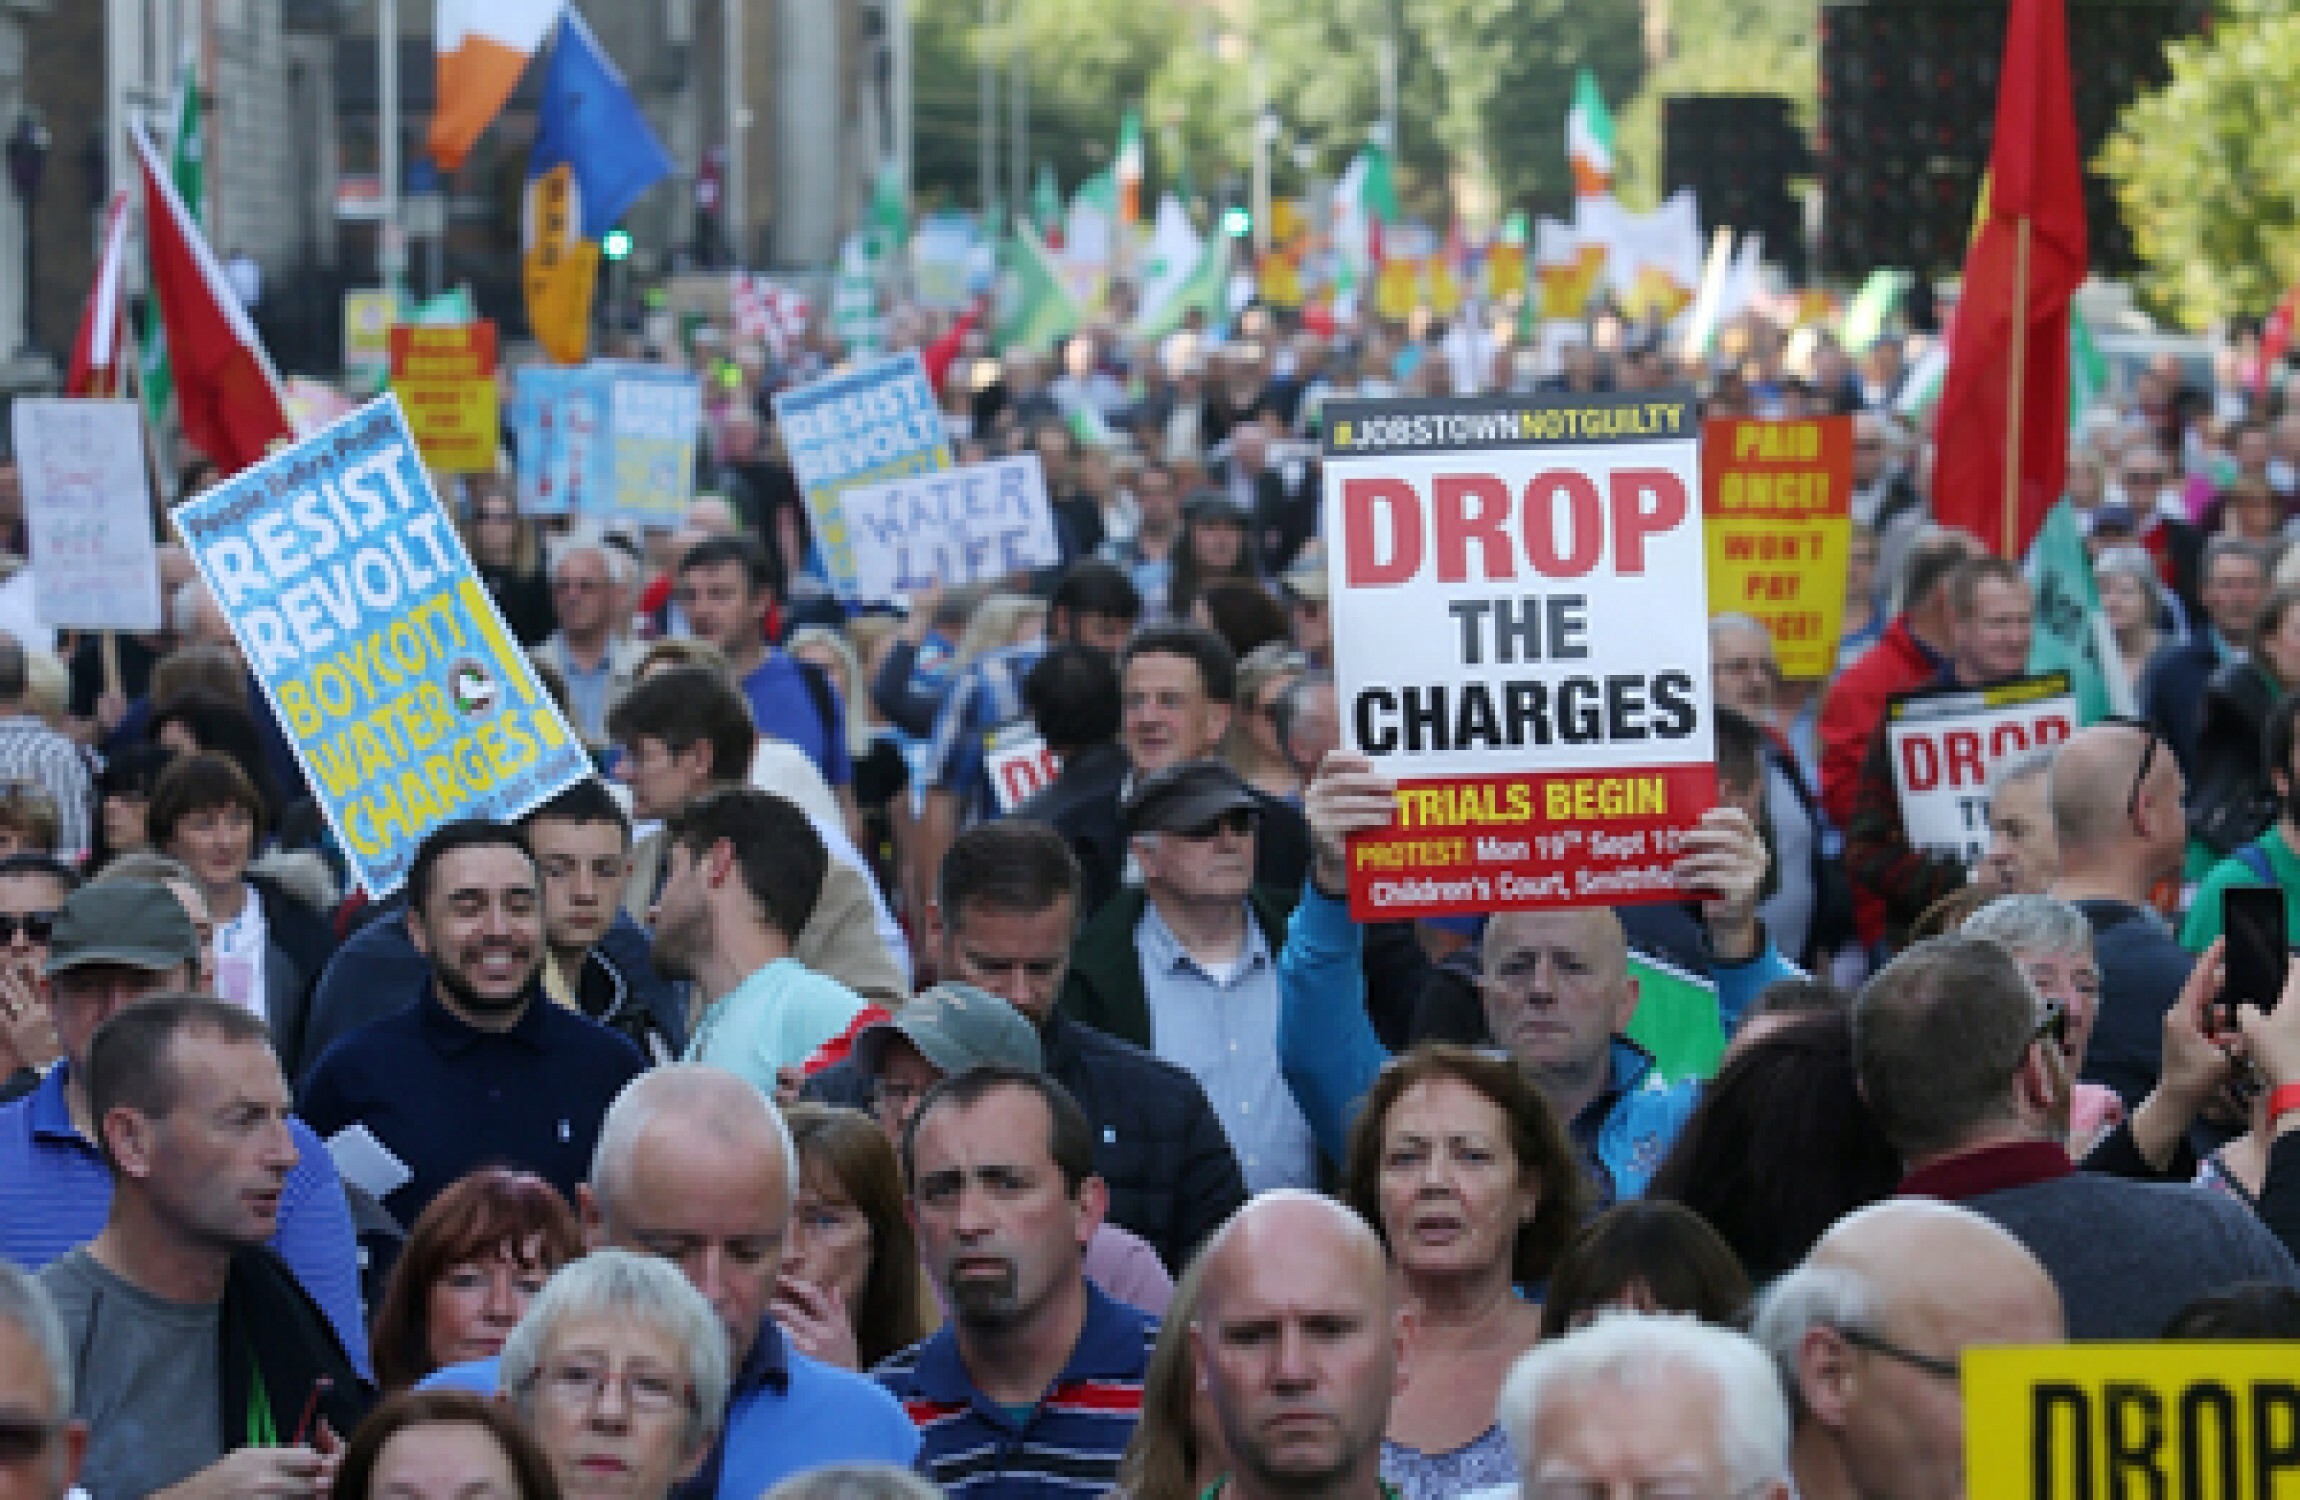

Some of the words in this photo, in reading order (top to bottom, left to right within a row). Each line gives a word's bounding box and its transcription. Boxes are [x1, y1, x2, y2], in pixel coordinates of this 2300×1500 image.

[785, 374, 923, 440] RESIST
[797, 412, 938, 478] REVOLT
[1735, 422, 1818, 458] PAID
[205, 444, 415, 605] RESIST
[861, 467, 1032, 542] WATER
[1340, 466, 1690, 590] DROP
[241, 512, 455, 676] REVOLT
[1745, 572, 1801, 601] PAY
[277, 592, 467, 738] BOYCOTT
[1448, 594, 1589, 664] THE
[308, 680, 455, 796] WATER
[1353, 669, 1699, 756] CHARGES
[1395, 783, 1534, 828] TRIALS
[1545, 773, 1666, 821] BEGIN
[2028, 1376, 2300, 1500] DROP
